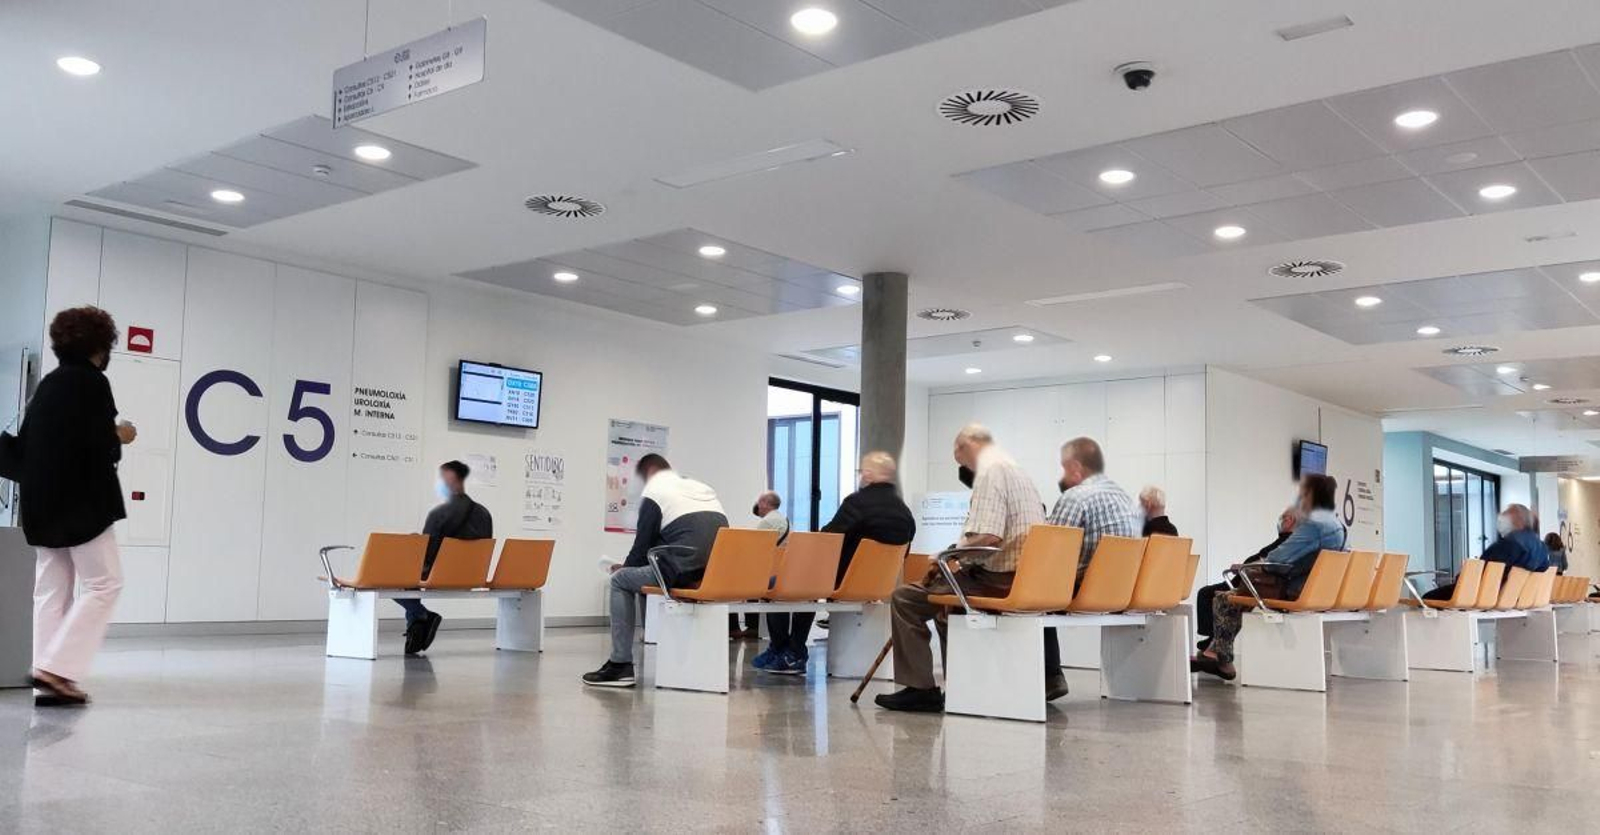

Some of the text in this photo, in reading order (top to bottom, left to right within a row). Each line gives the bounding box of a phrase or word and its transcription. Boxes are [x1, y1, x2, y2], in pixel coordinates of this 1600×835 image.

[354, 387, 406, 401] PNEUMOLOXÍA
[354, 398, 391, 409] UROLOXÍA
[365, 410, 395, 420] INTERNA
